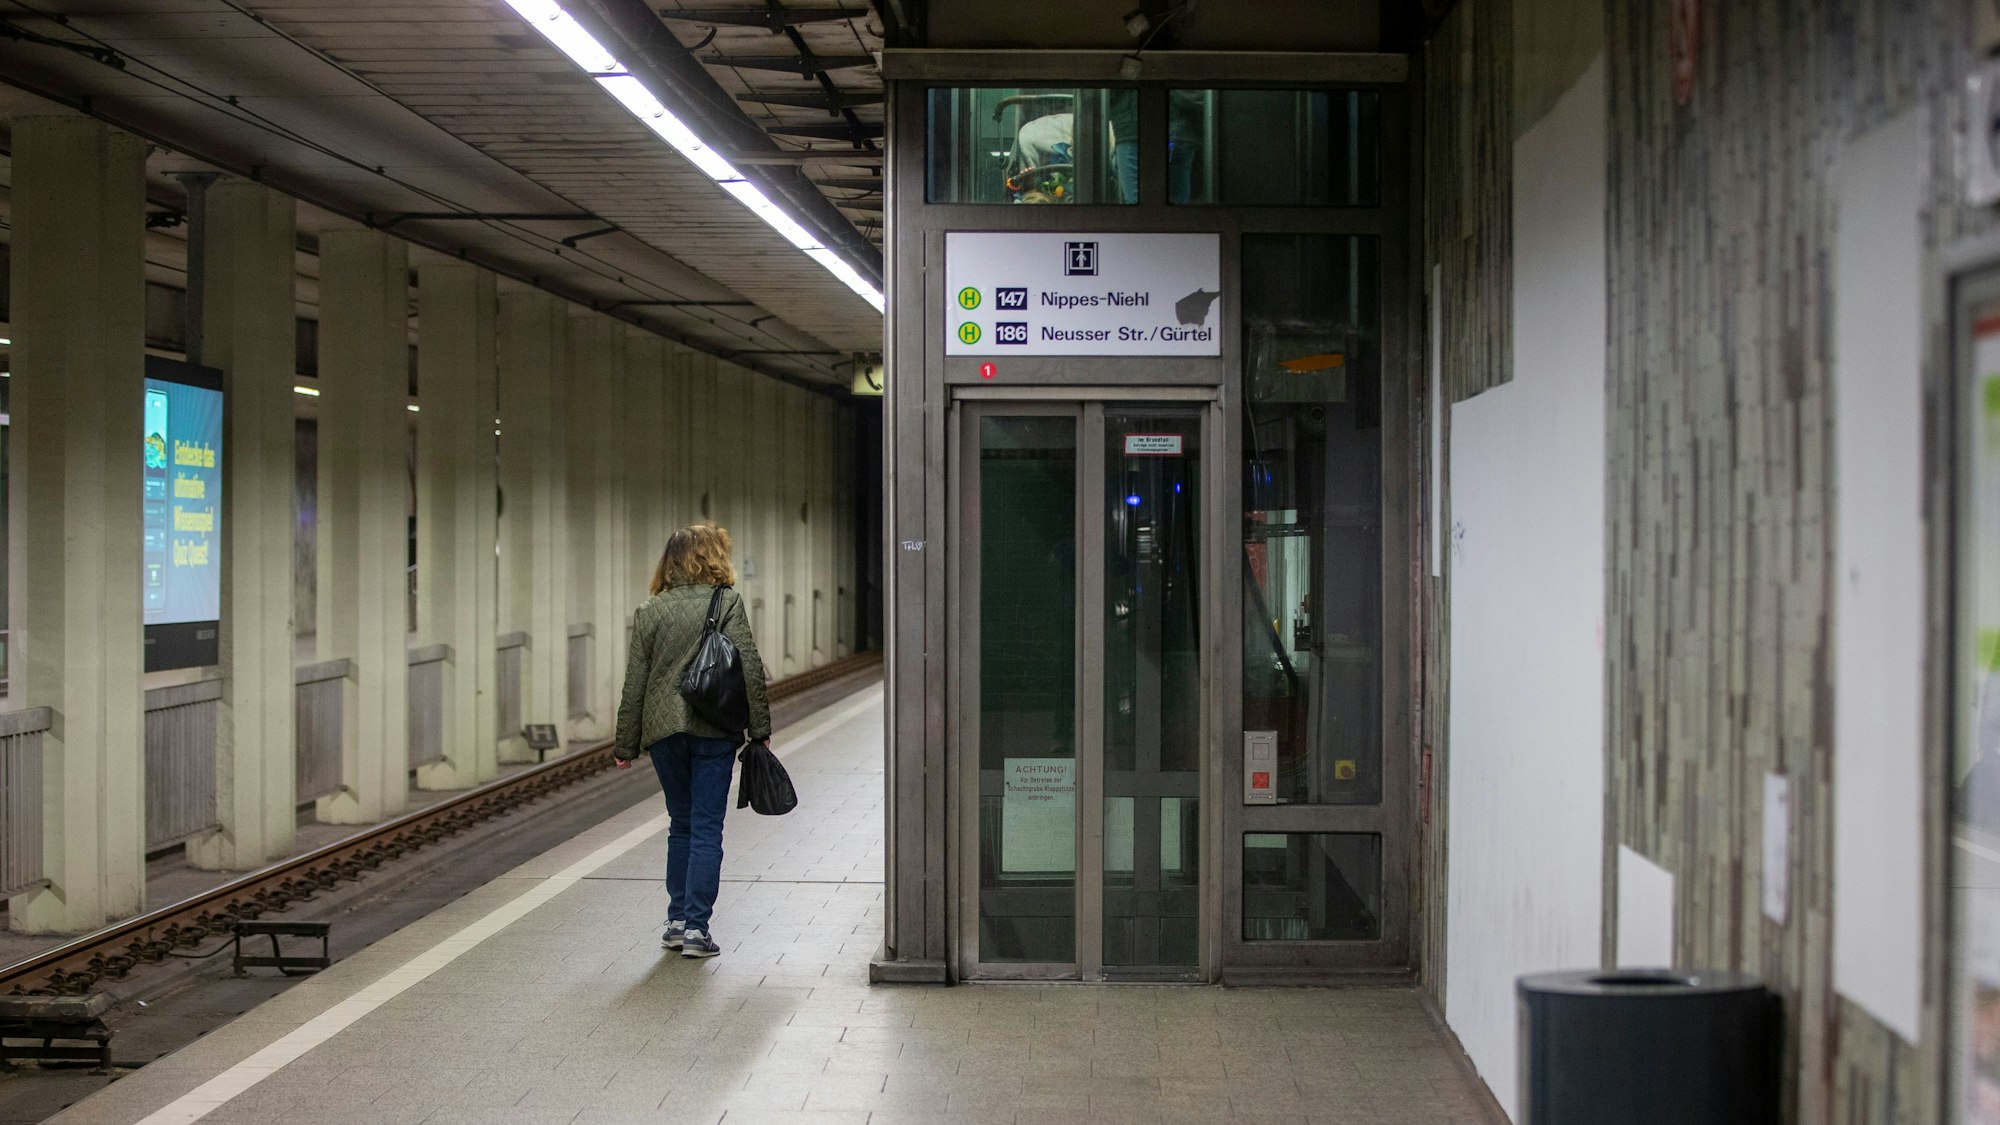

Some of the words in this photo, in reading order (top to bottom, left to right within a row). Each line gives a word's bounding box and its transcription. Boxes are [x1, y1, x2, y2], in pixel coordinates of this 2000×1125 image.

[997, 290, 1026, 307] 147
[1041, 291, 1150, 309] Nippes-Niehl
[996, 325, 1027, 342] 186
[1041, 326, 1111, 342] Neusser
[1015, 765, 1067, 774] ACHTUNG!
